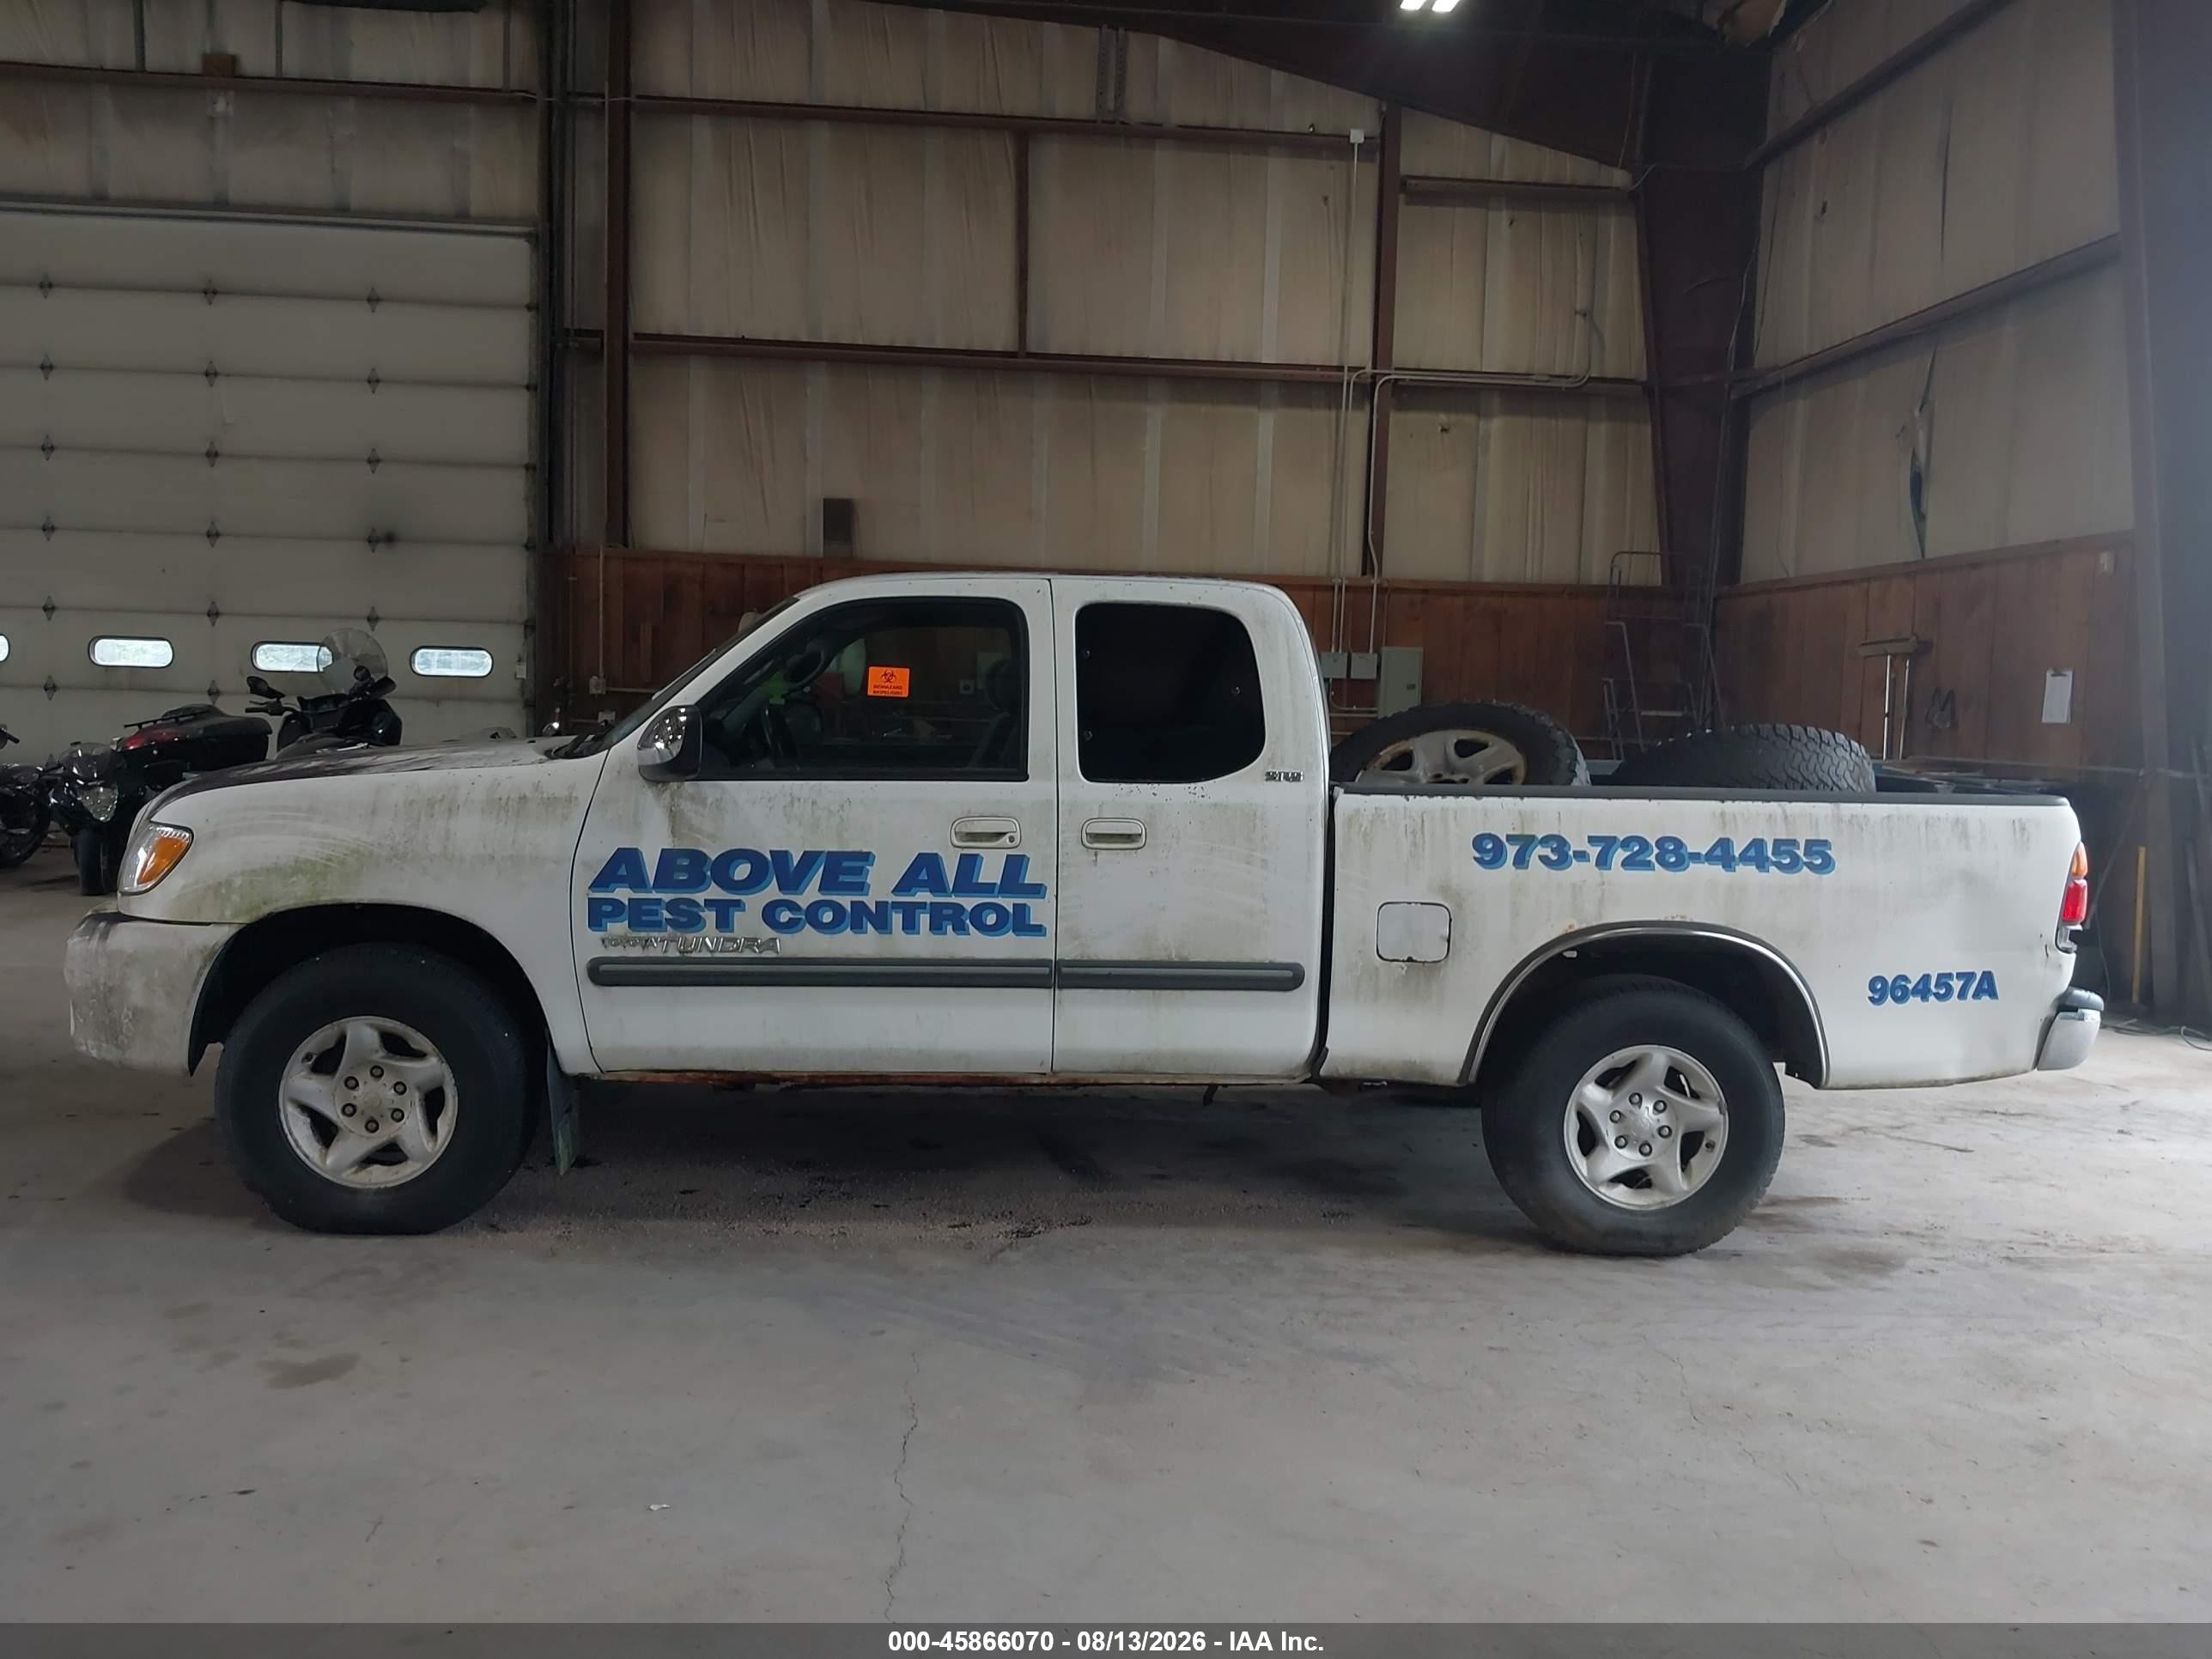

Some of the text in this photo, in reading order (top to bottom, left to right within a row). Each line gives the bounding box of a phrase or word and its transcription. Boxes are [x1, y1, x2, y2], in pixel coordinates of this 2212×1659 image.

[587, 847, 1048, 899] ABOVE ALL
[1471, 832, 1837, 876] 973-728-4455
[586, 896, 1048, 937] PEST CONTROL
[659, 936, 781, 955] TUNDRA
[1867, 969, 1999, 1006] 96457A
